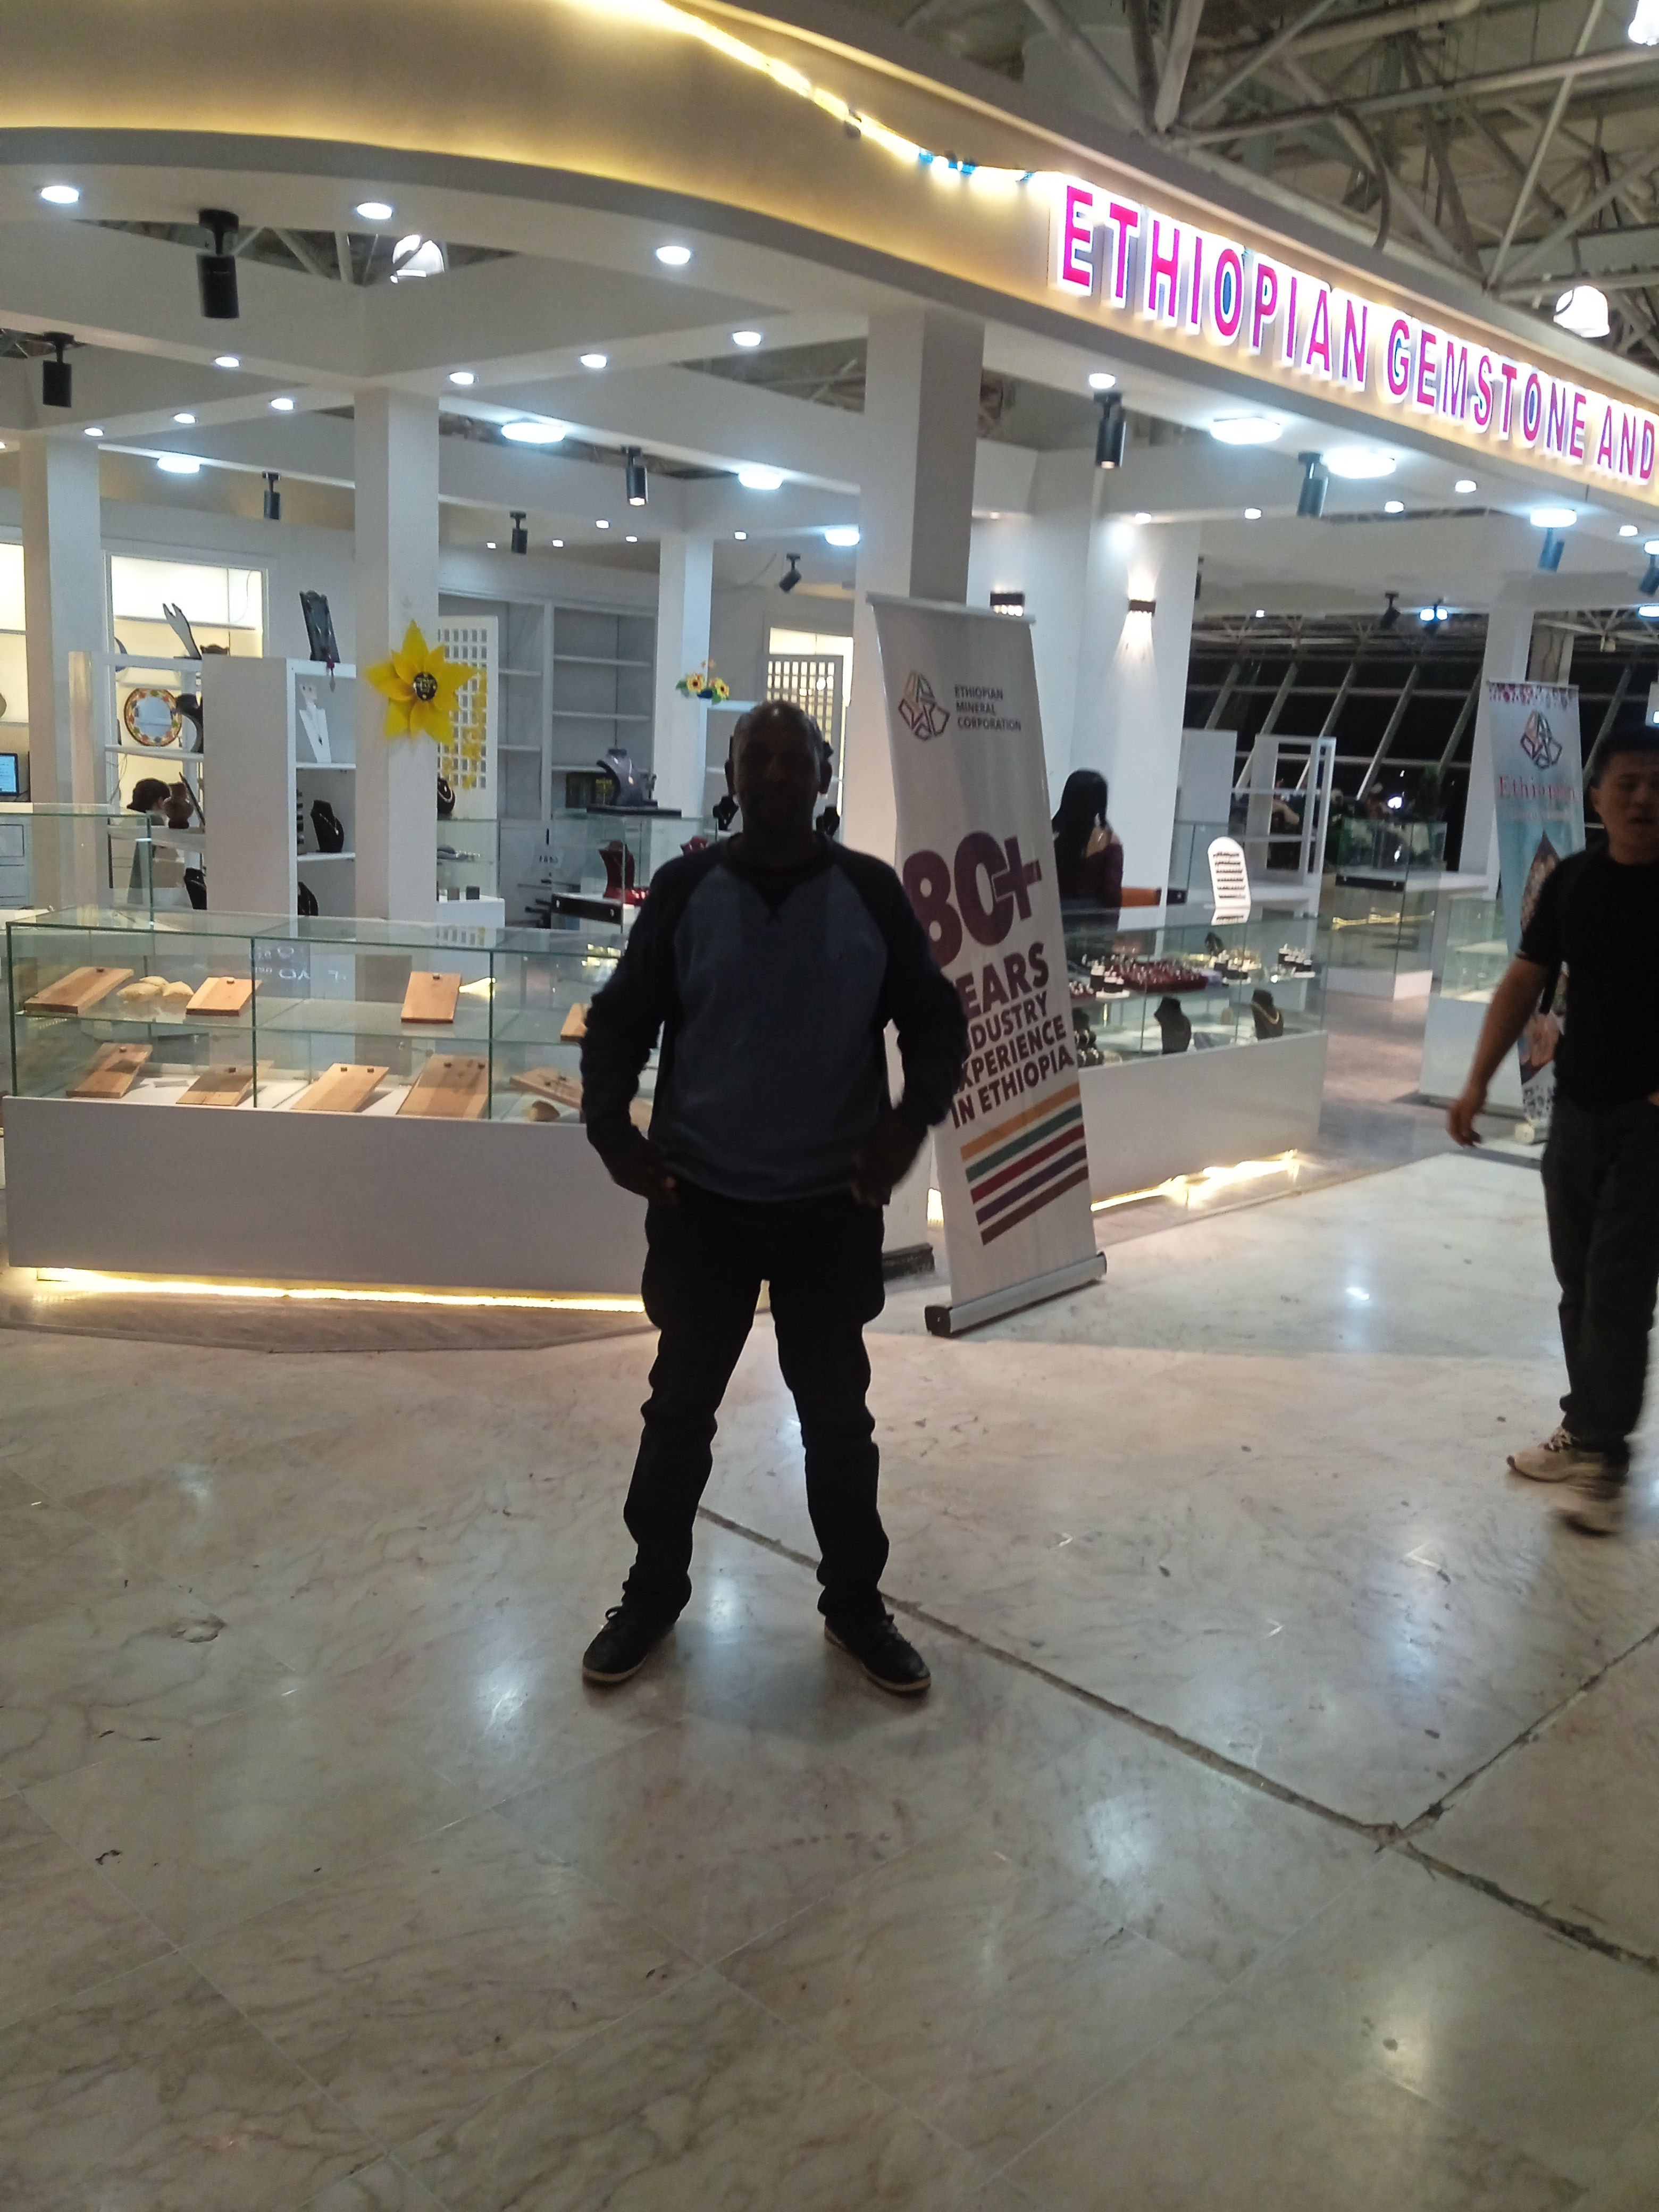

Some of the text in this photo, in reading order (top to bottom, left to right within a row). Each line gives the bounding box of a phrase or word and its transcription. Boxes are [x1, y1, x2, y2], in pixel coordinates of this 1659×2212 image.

[1061, 183, 1655, 480] ETHIOPIAN GEMSTONE AND
[954, 684, 1003, 701] ETHIOPIAN
[956, 700, 996, 716] MINERAL
[957, 716, 1021, 732] CORPORATION
[954, 941, 1049, 1019] EARS
[959, 1015, 1067, 1092] XPERIENCE
[970, 990, 1048, 1051] DUSTRY
[951, 1044, 1075, 1129] IN ETHIOPIA
